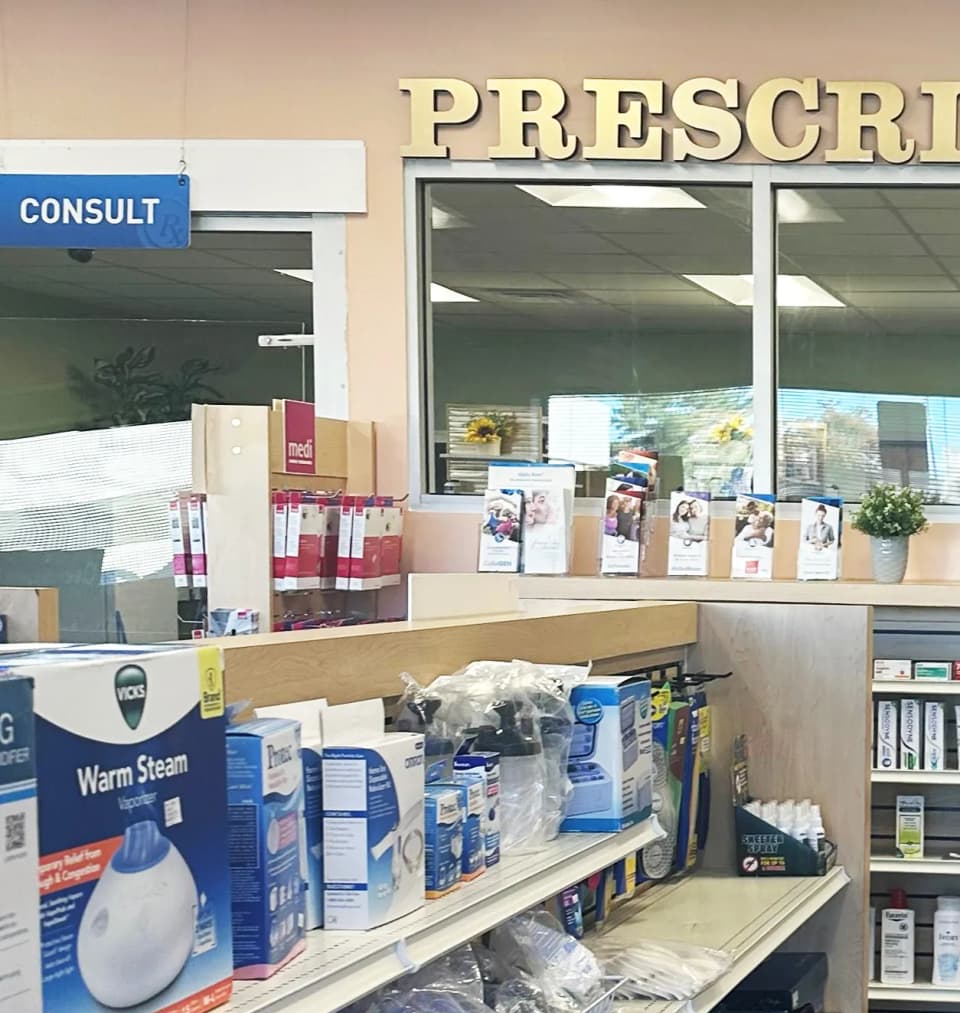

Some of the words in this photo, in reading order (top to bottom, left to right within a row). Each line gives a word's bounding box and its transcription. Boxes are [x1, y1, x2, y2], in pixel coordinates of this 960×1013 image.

[20, 197, 160, 225] CONSULT
[287, 439, 313, 459] medi
[116, 683, 146, 701] VICKS
[883, 703, 891, 740] SENSODYNE
[906, 700, 914, 743] SENSODYNE
[930, 704, 938, 741] SENSODYNE
[76, 764, 134, 797] Warm
[136, 753, 189, 785] Steam
[938, 933, 959, 941] IVORY
